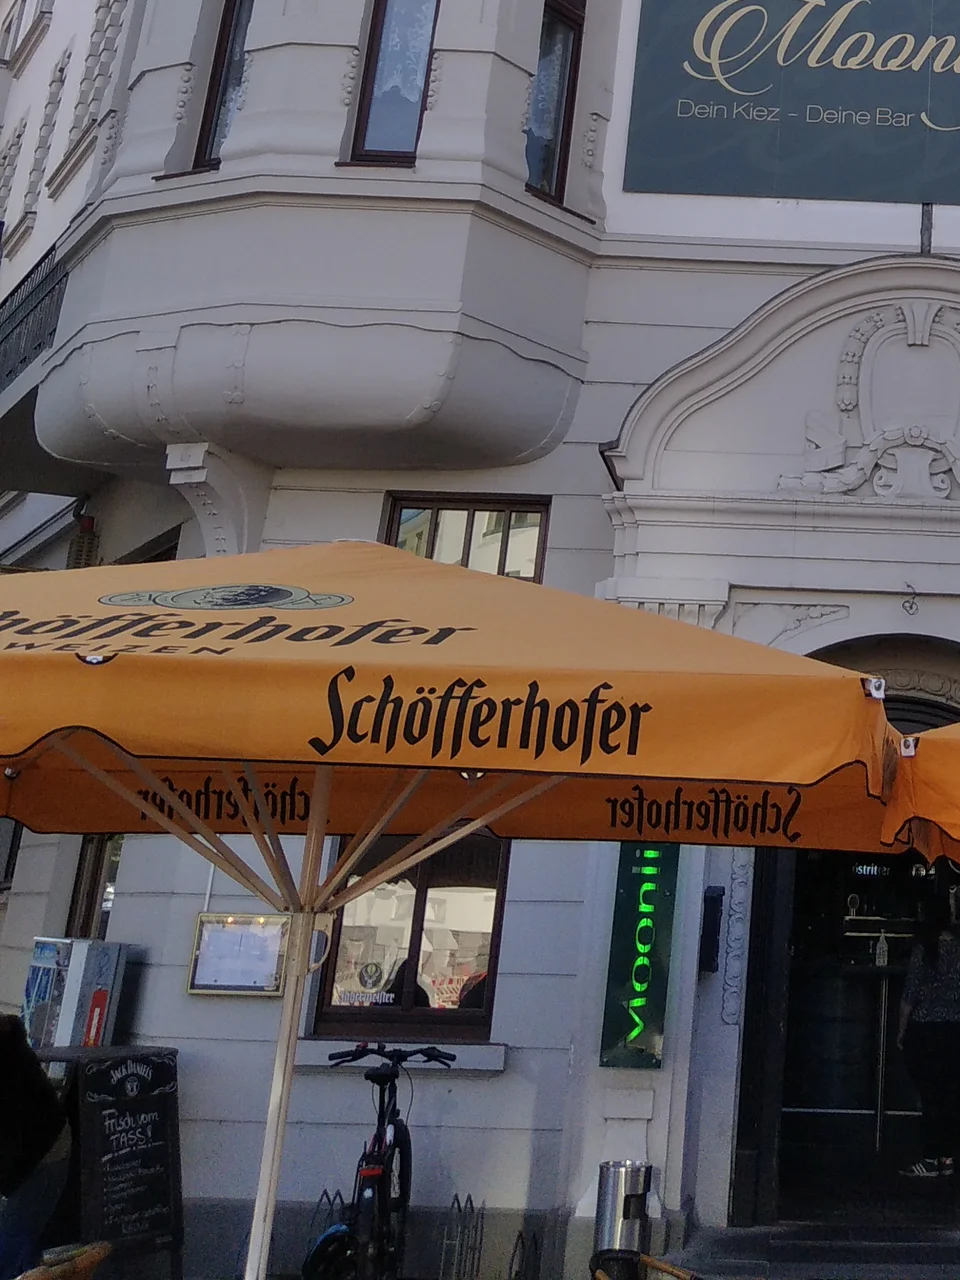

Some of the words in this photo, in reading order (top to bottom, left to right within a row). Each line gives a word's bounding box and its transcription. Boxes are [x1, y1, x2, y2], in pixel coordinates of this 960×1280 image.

[677, 99, 728, 119] Dein
[732, 101, 781, 121] Kiez
[805, 104, 871, 125] Deine
[876, 107, 915, 127] Bar
[0, 609, 478, 647] höfferhofer
[3, 642, 235, 655] WEIZEN
[308, 665, 653, 766] Schöfferhofer
[613, 848, 662, 1054] Moonli
[137, 1112, 160, 1126] vom
